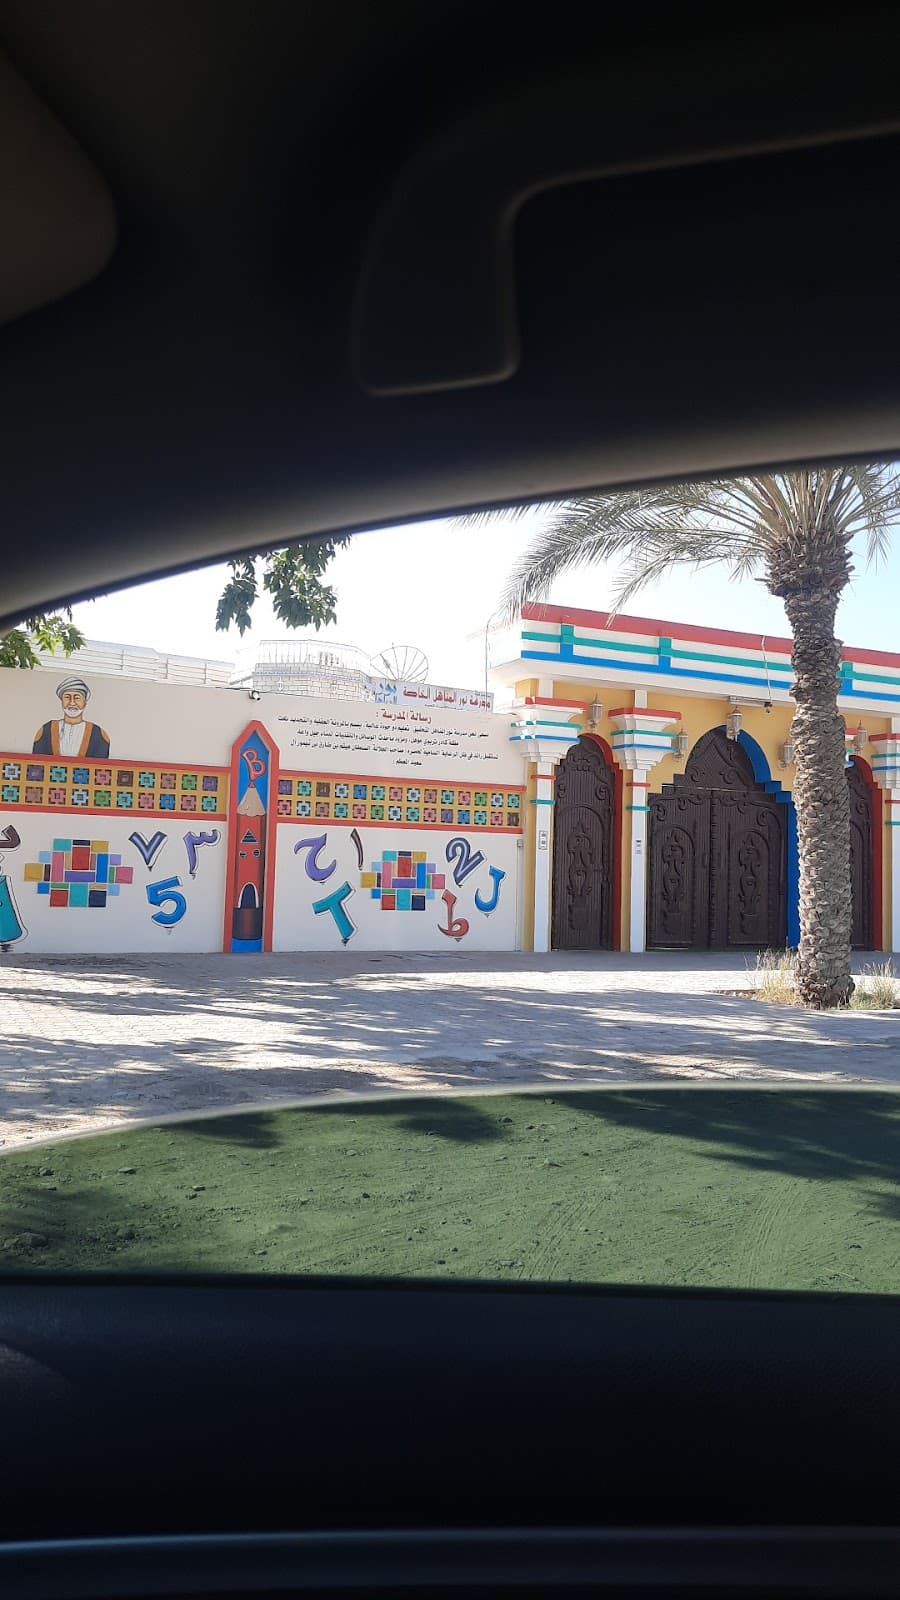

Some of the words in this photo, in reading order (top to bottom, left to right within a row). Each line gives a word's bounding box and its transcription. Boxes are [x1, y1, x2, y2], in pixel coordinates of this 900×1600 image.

[432, 689, 457, 703] المناهل
[459, 694, 468, 706] نور
[382, 708, 409, 721] المدرسة
[410, 708, 432, 724] رسالة
[242, 747, 266, 781] B
[445, 837, 487, 887] 2
[146, 876, 187, 927] 5
